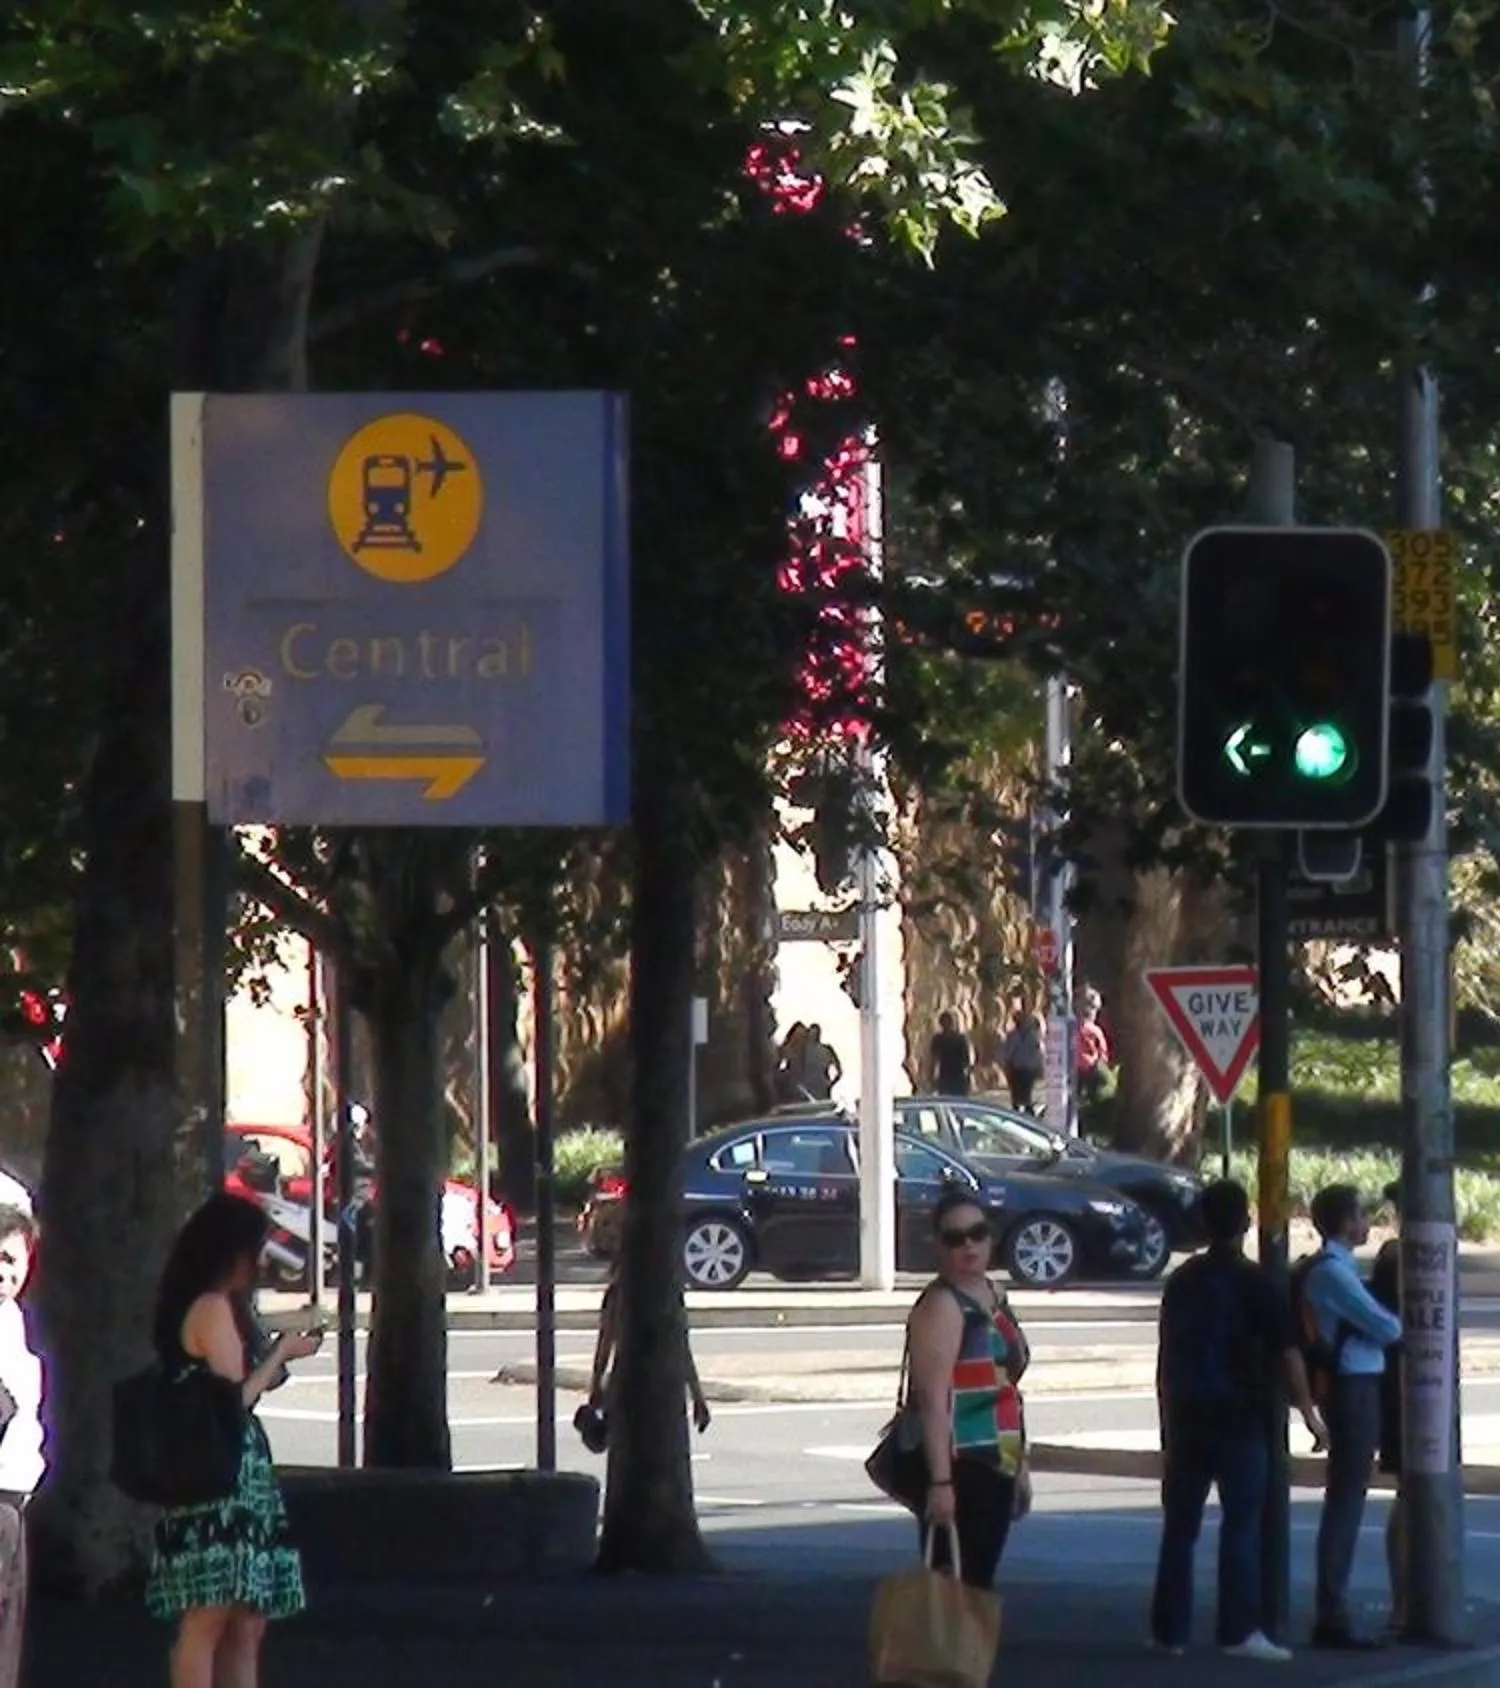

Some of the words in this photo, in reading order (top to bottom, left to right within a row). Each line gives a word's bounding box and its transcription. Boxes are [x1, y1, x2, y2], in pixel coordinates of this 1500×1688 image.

[279, 621, 535, 681] Central
[1188, 991, 1250, 1015] GIVE
[1201, 1017, 1242, 1038] WAY
